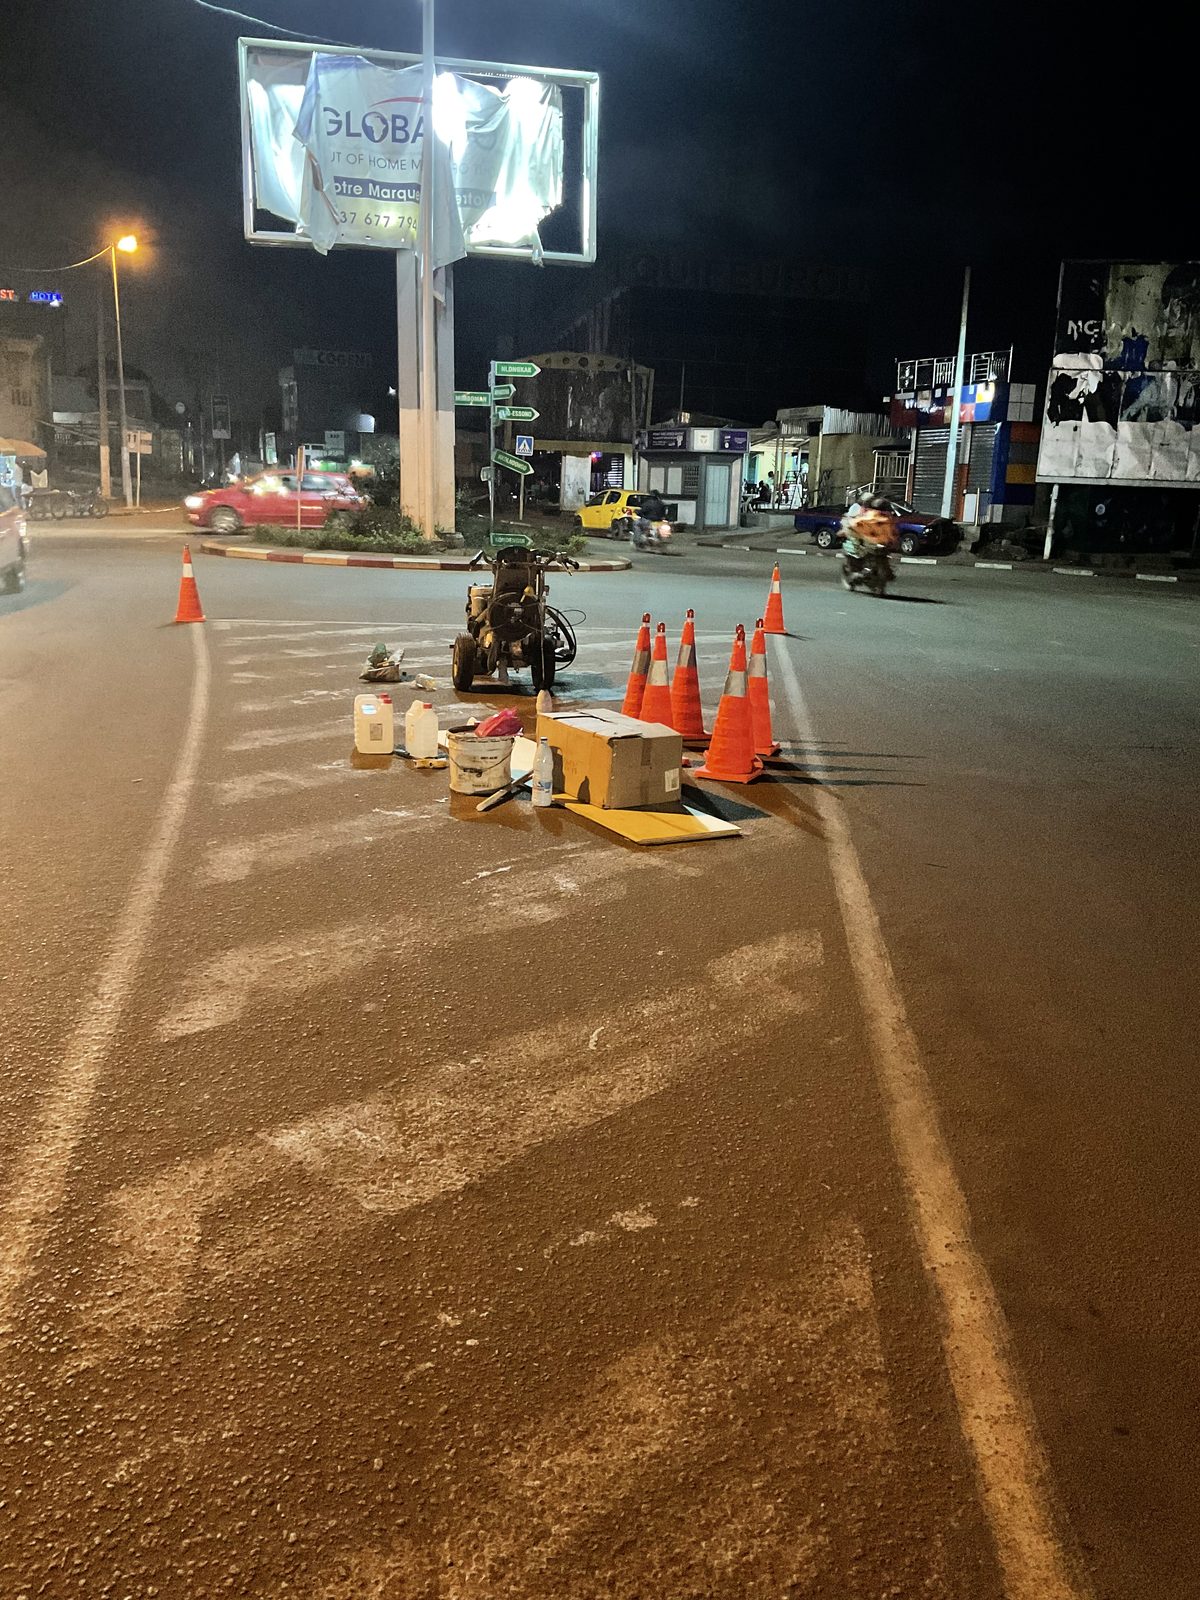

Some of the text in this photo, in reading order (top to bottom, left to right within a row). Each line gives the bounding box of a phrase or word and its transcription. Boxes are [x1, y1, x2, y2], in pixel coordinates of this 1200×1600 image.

[346, 153, 364, 166] OF
[369, 156, 407, 170] HOME
[364, 213, 390, 228] 677
[0, 289, 63, 302] ST HOTEL
